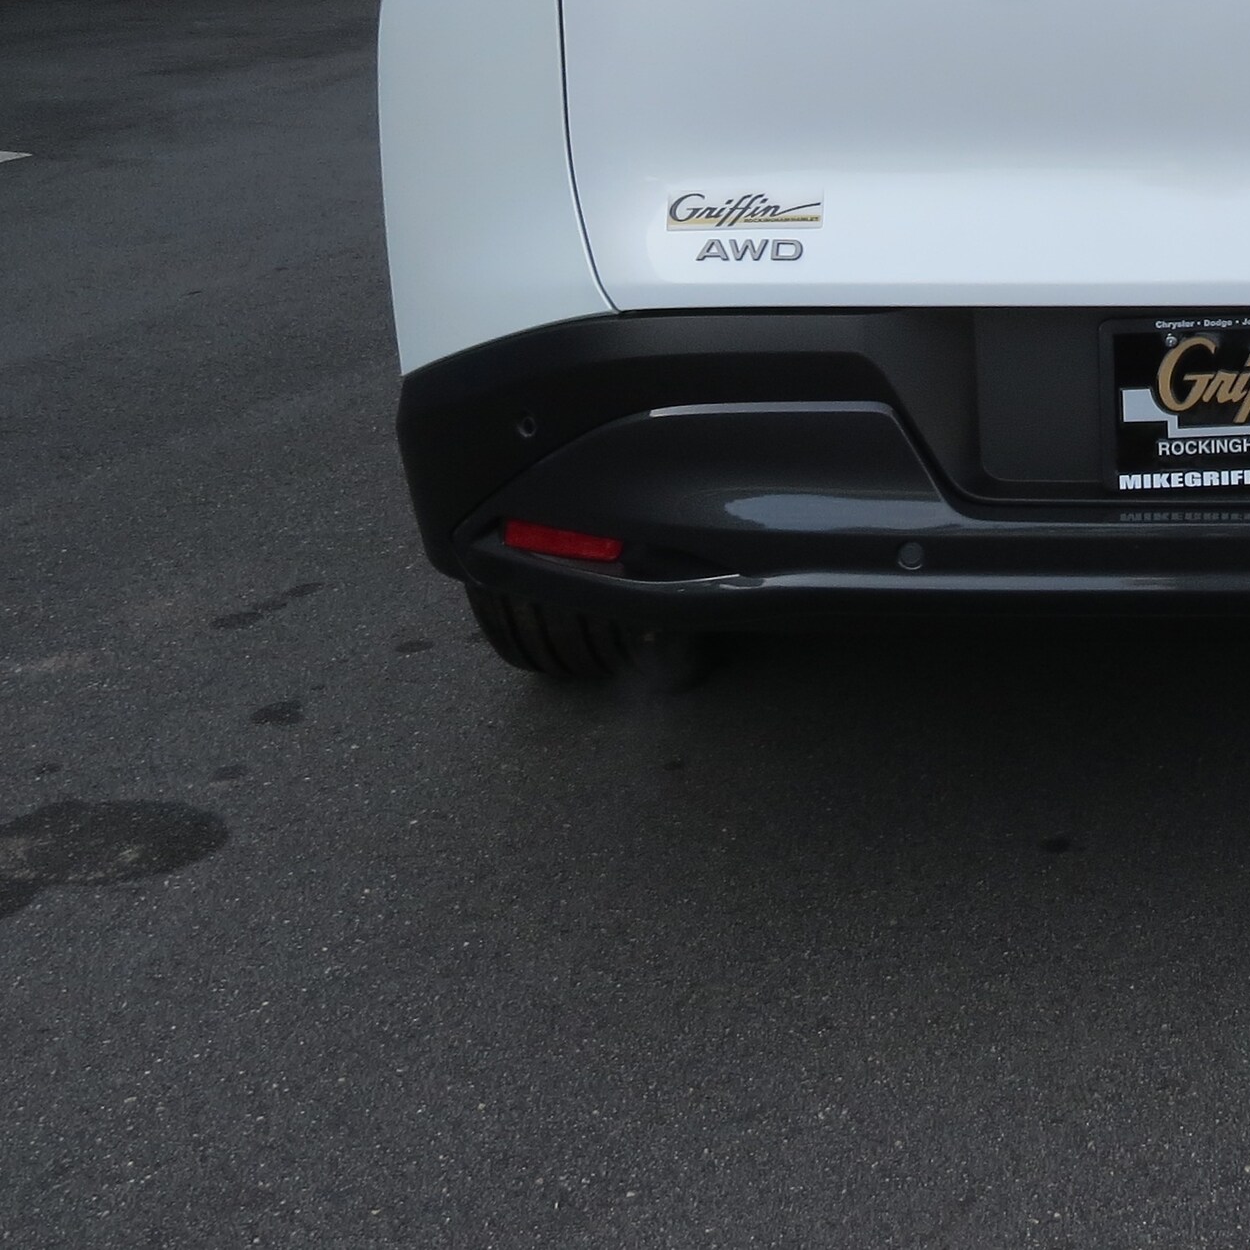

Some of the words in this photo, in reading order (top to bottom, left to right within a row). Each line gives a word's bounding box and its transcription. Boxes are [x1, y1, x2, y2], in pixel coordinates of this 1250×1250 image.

[669, 193, 821, 227] Griffin
[696, 238, 804, 261] AWD
[1155, 320, 1195, 330] Chrysler
[1203, 318, 1233, 328] Dodge
